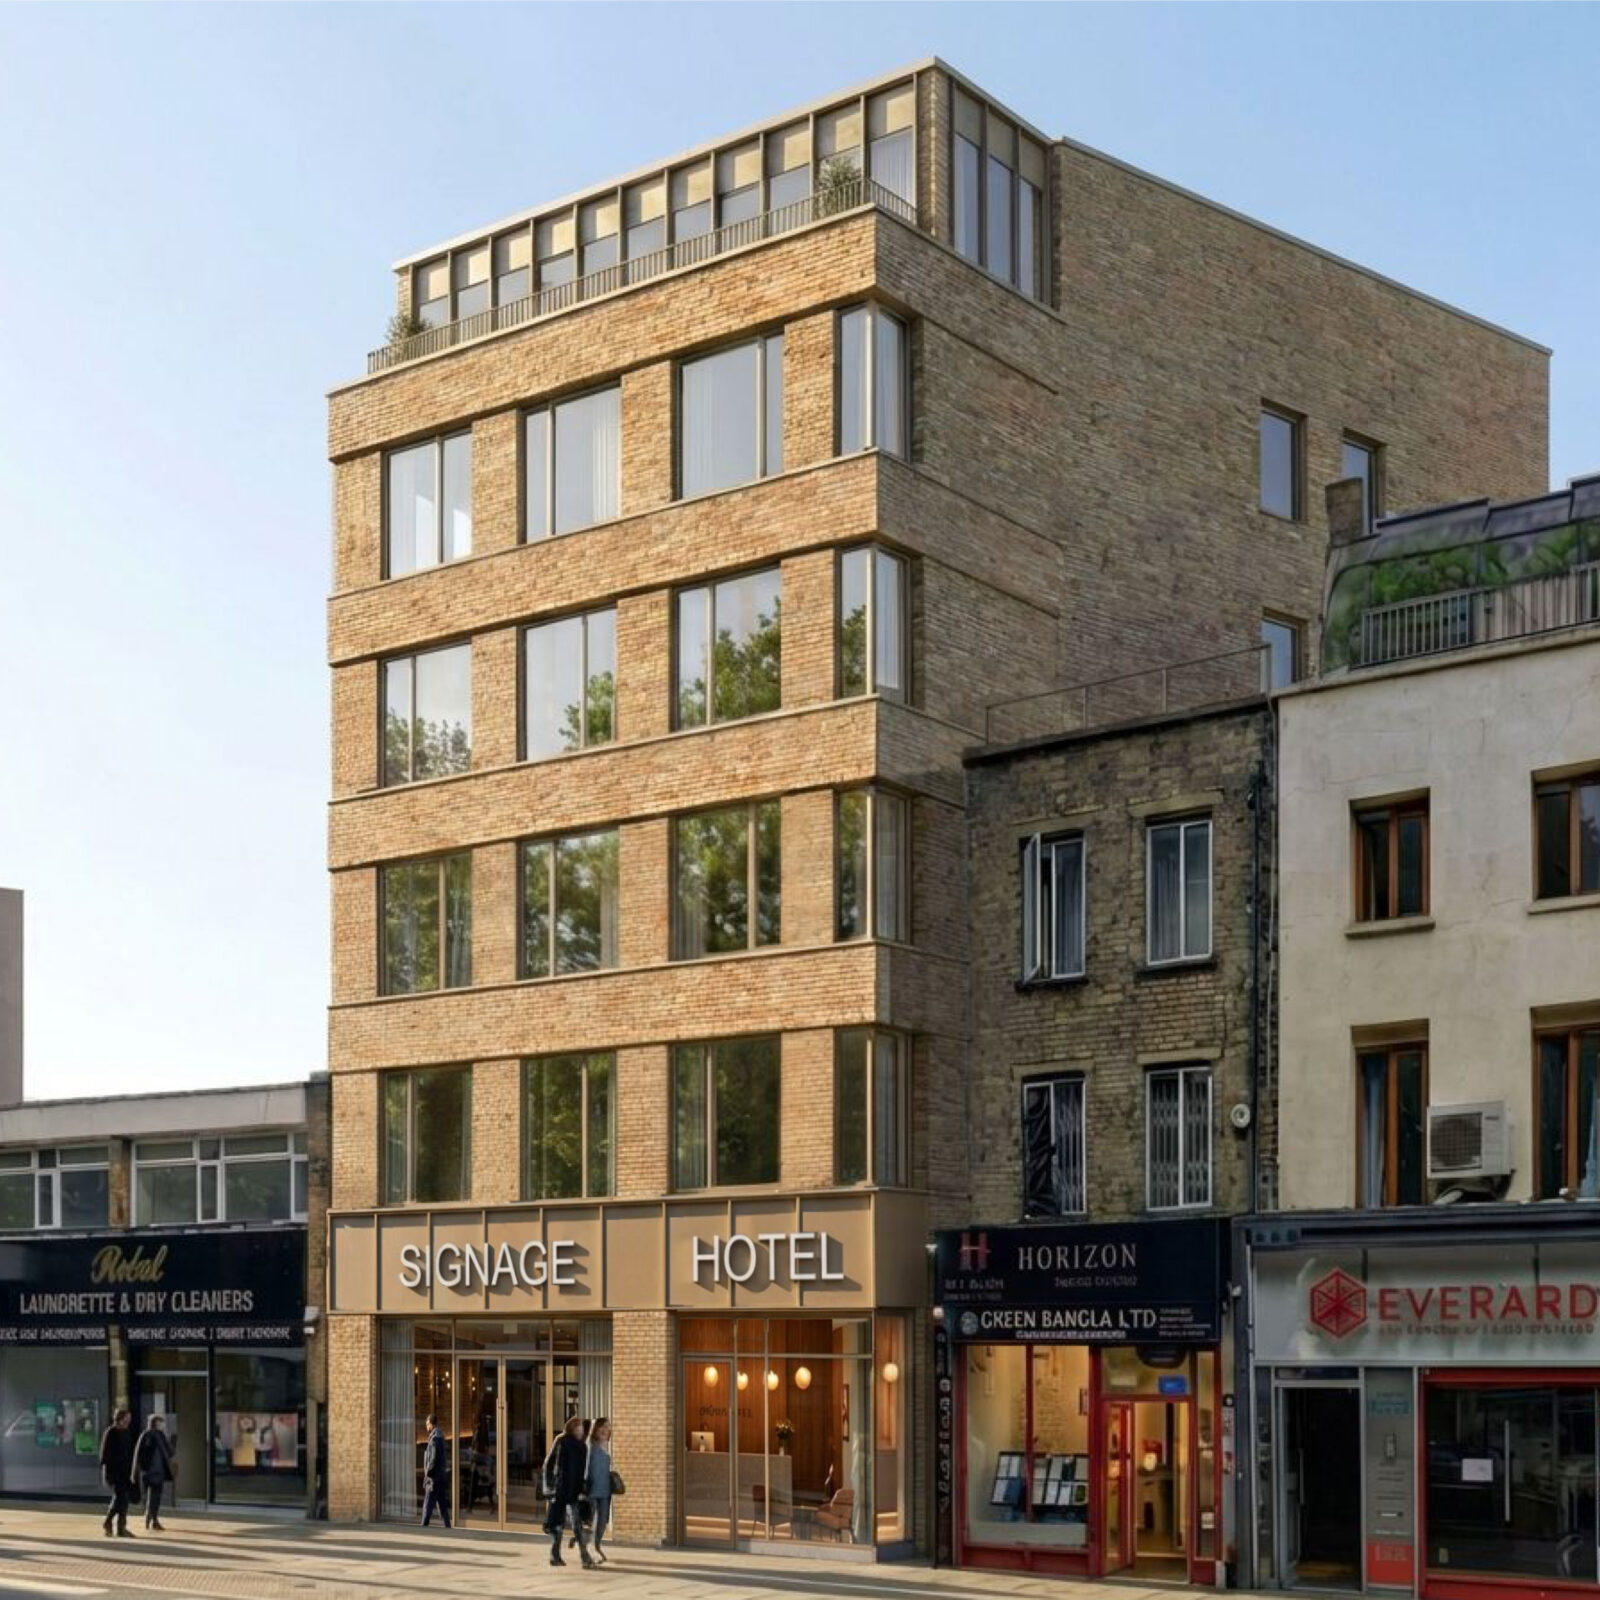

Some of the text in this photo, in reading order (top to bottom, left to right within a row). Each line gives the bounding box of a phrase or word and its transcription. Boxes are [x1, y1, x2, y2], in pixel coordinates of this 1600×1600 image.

[398, 1232, 845, 1288] SIGNAGE HOTEL
[1018, 1243, 1138, 1270] HORIZON
[120, 1292, 131, 1314] &
[135, 1291, 167, 1314] DRY
[171, 1289, 254, 1313] CLEANERS
[1377, 1283, 1599, 1322] EVERARD
[1118, 1308, 1158, 1329] LTD
